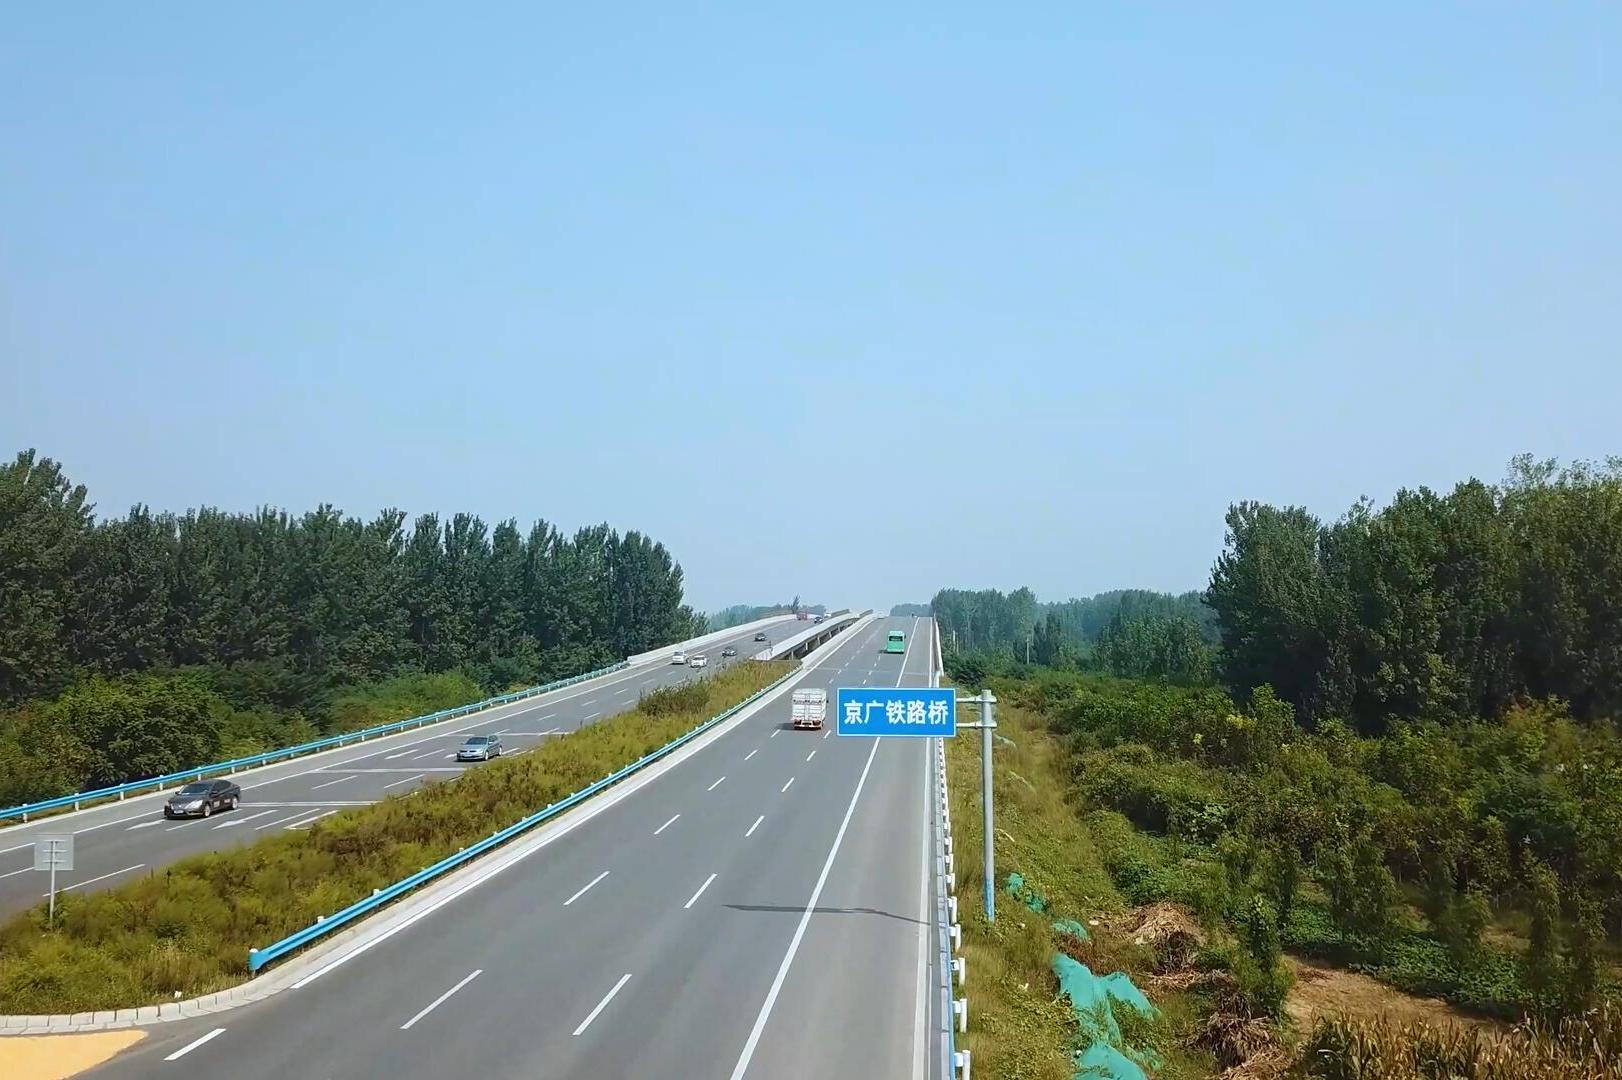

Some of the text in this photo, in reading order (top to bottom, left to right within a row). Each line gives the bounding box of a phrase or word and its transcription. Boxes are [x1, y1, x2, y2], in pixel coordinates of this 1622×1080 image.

[843, 699, 949, 725] 京广铁路桥
